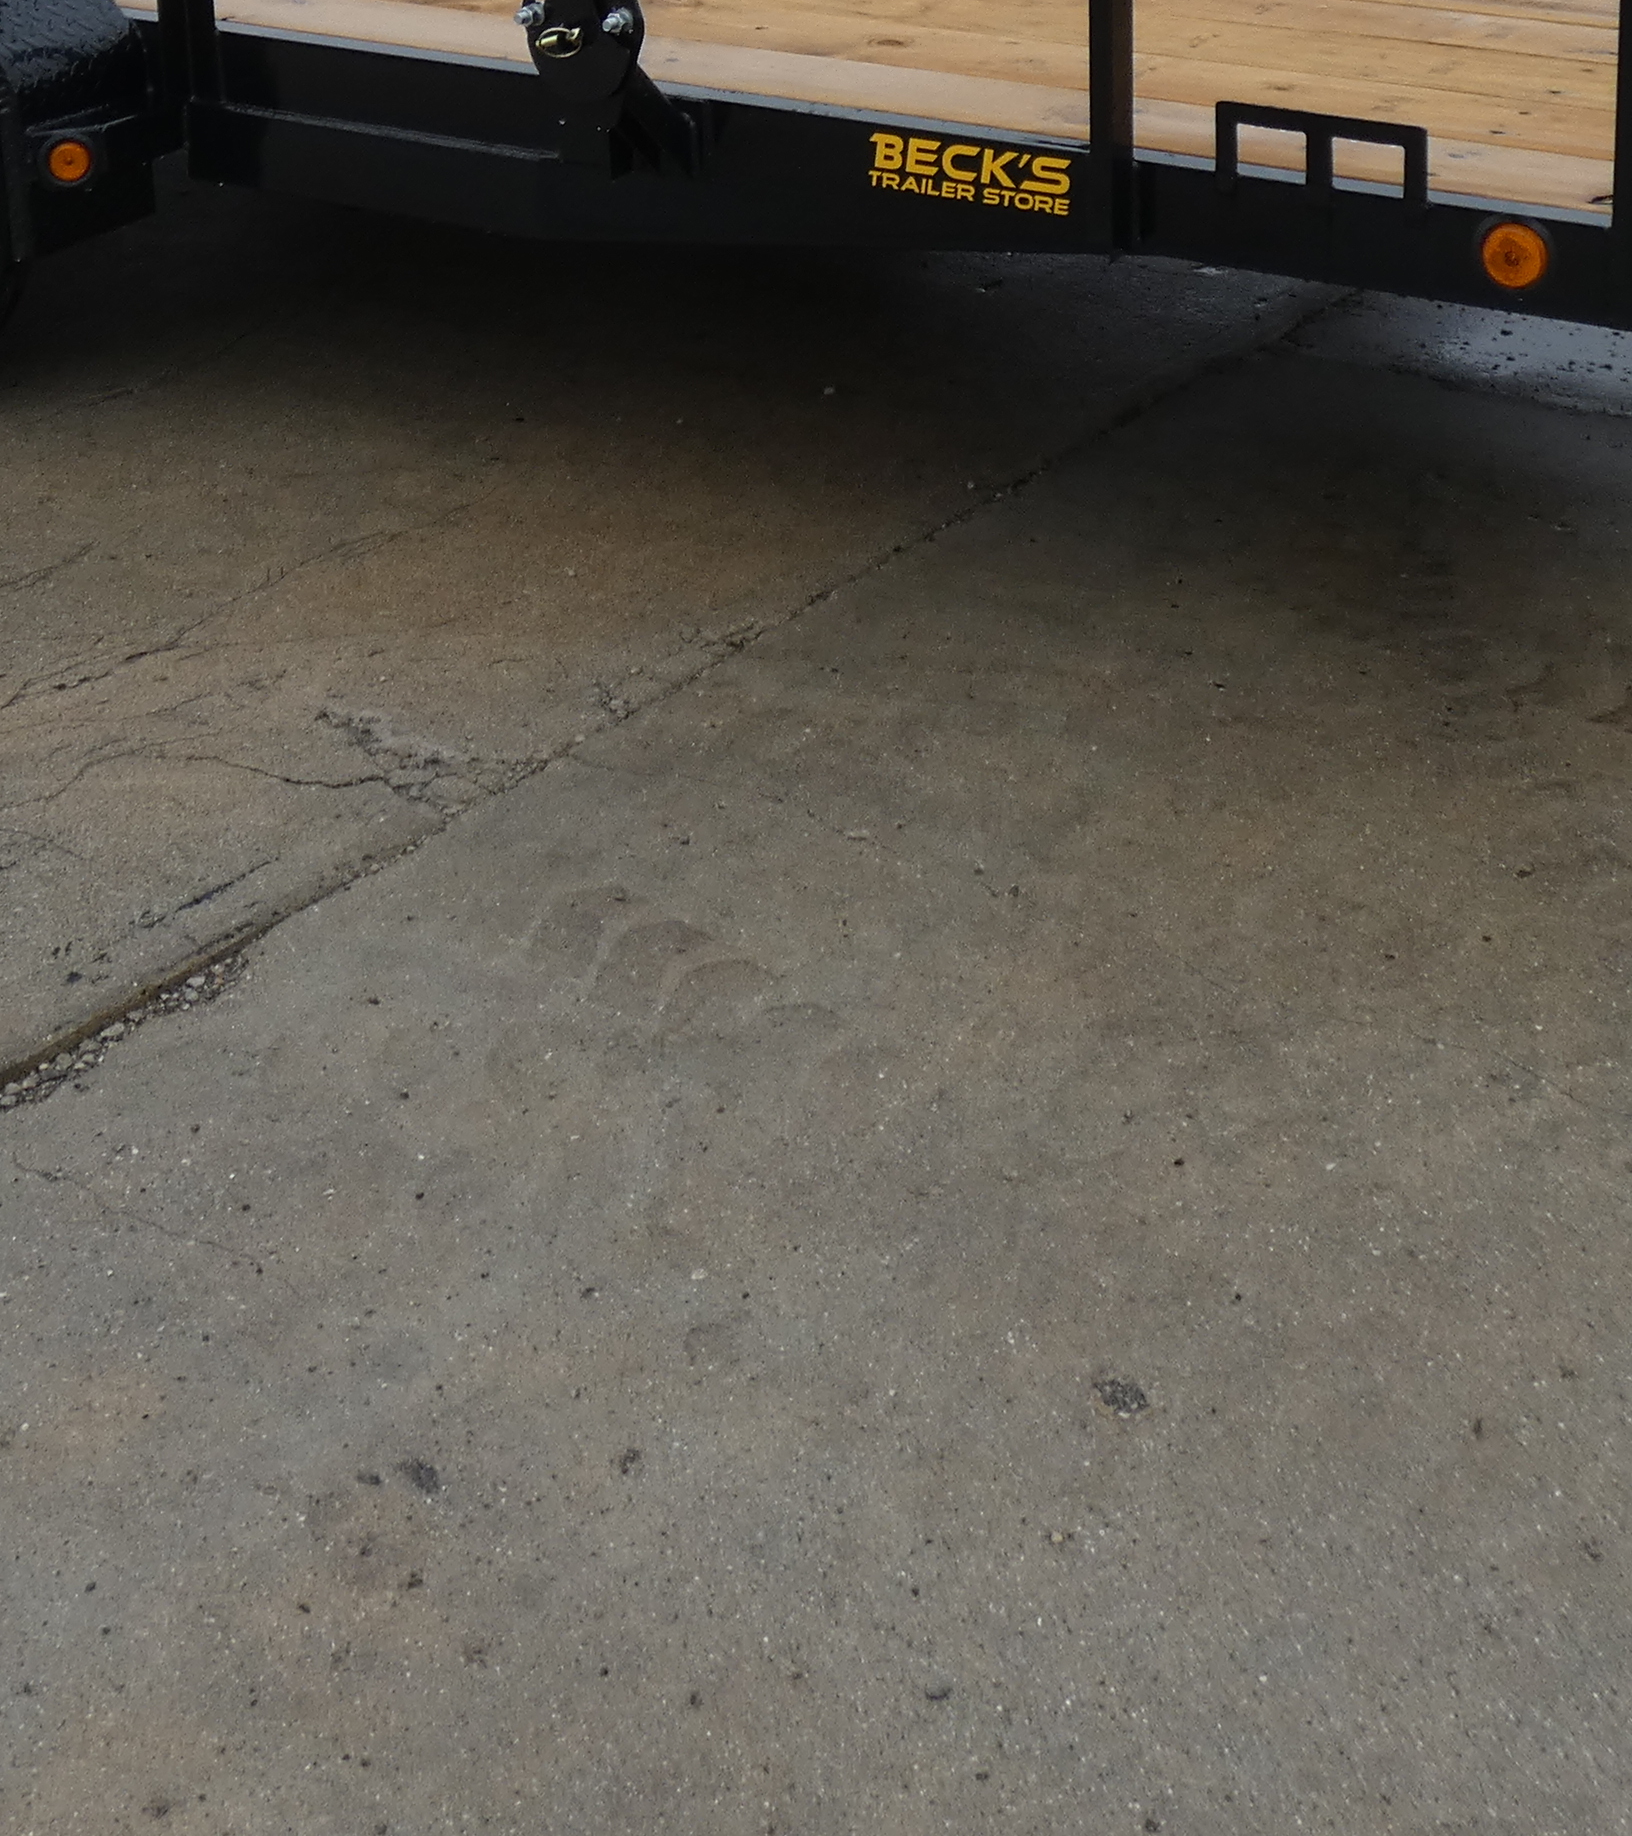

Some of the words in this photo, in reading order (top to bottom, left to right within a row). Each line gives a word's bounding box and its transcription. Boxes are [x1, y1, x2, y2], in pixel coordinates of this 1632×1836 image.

[869, 132, 1072, 195] BECK'S
[868, 170, 976, 202] TRAILER
[982, 187, 1071, 216] STORE
